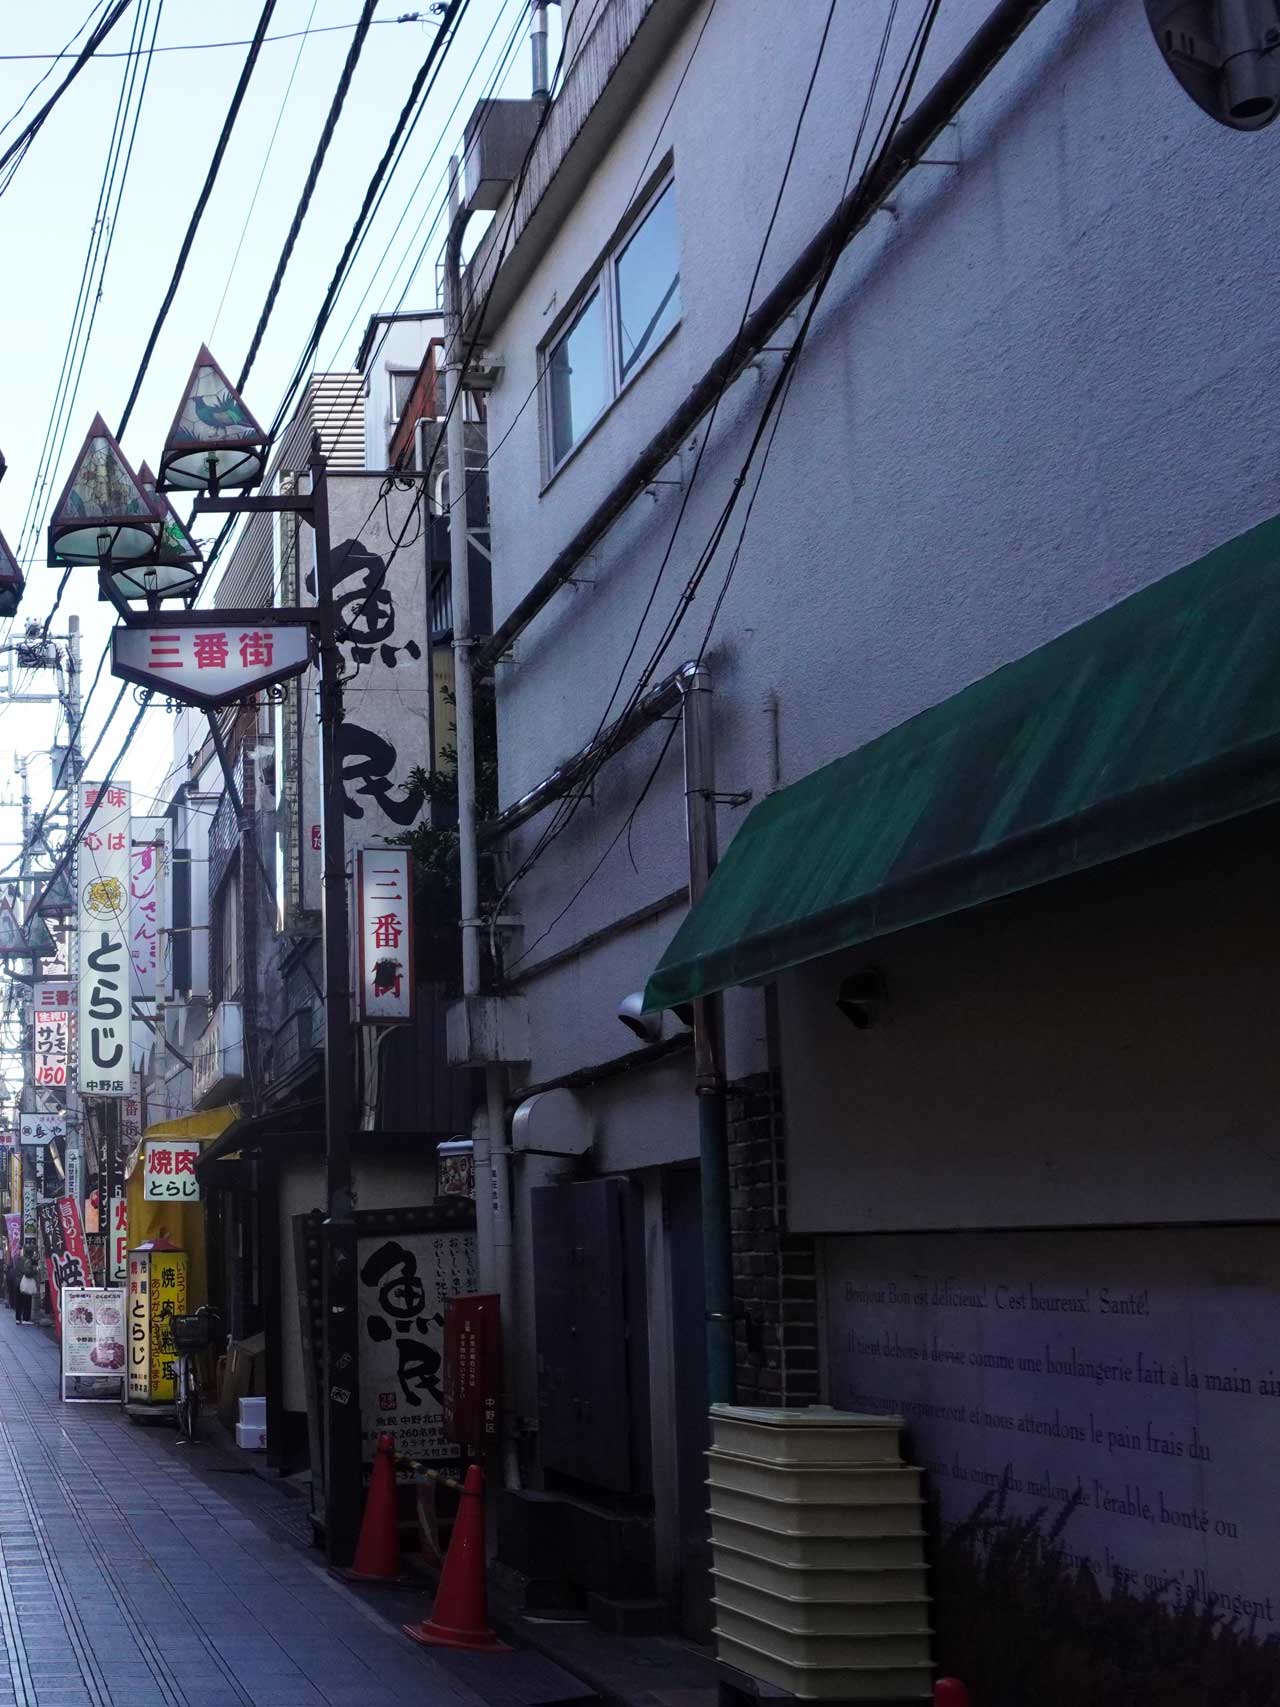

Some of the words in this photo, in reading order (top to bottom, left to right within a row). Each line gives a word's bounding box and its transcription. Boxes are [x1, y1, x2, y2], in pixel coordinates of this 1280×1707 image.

[149, 632, 274, 668] 三番街
[83, 789, 103, 851] 真心
[107, 789, 126, 851] 味は
[88, 932, 123, 1068] とらじ
[87, 1080, 124, 1091] 中野店
[149, 1150, 200, 1175] 焼肉
[150, 1181, 196, 1197] とらじ
[132, 1300, 145, 1365] とらじ
[360, 1241, 446, 1407] 魚民
[1046, 1344, 1132, 1385] boulangerie
[1136, 1351, 1165, 1385] fait
[1183, 1355, 1199, 1389] la
[1204, 1367, 1252, 1394] main
[485, 1398, 495, 1433] 中野区
[1017, 1408, 1086, 1441] attendons
[1090, 1412, 1103, 1444] le
[1107, 1425, 1141, 1453] pain
[1146, 1421, 1184, 1457] frais
[1189, 1426, 1211, 1461] du
[1159, 1491, 1209, 1532] bonté
[1215, 1518, 1238, 1539] ou
